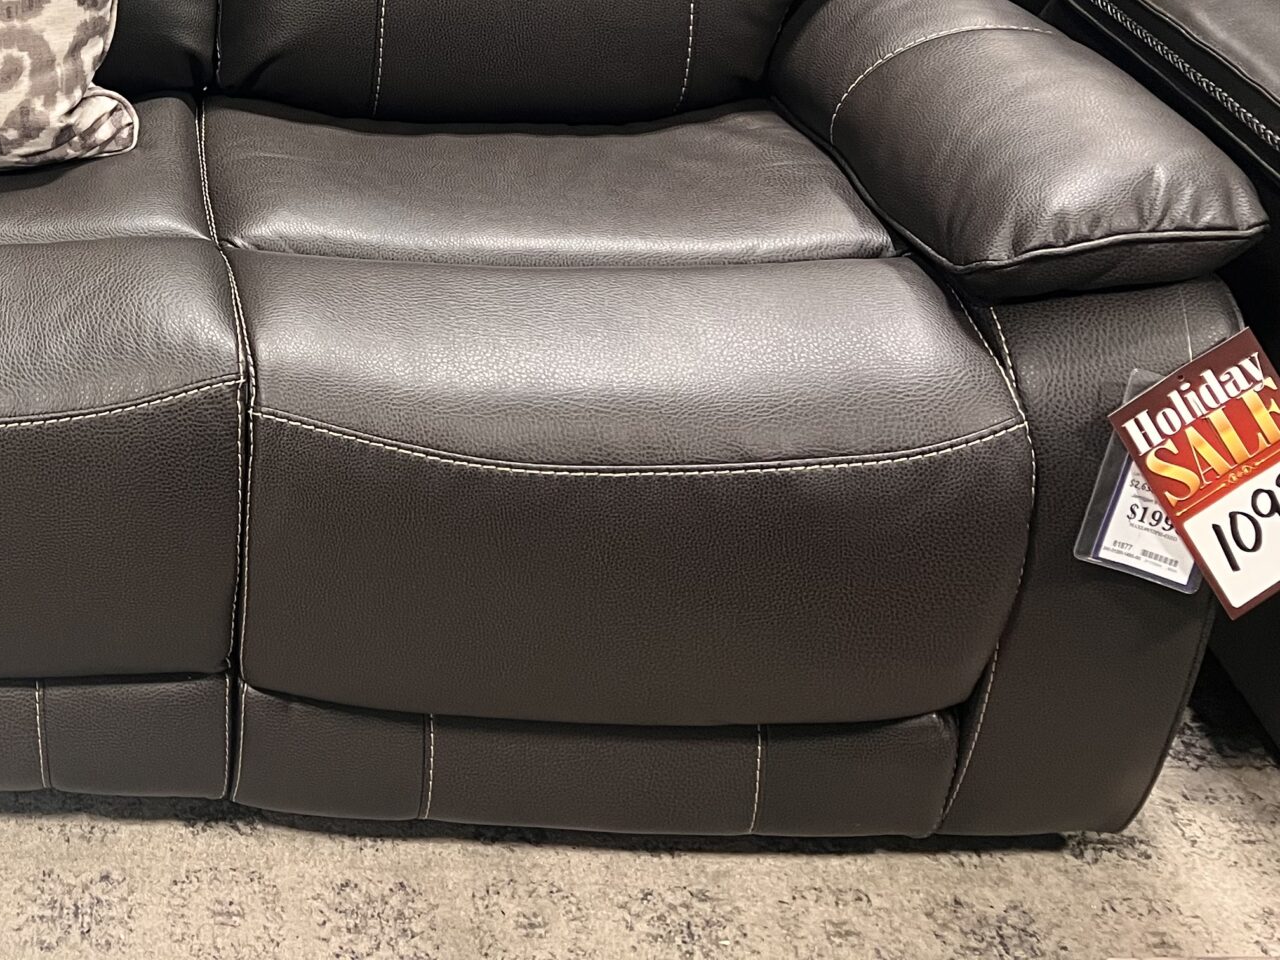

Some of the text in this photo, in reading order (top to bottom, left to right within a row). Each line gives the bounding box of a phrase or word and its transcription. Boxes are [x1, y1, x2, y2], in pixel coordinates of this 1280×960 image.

[1122, 352, 1266, 456] Holiday
[1145, 376, 1280, 507] SALE
[1127, 503, 1179, 535] $199
[1212, 473, 1280, 571] 109
